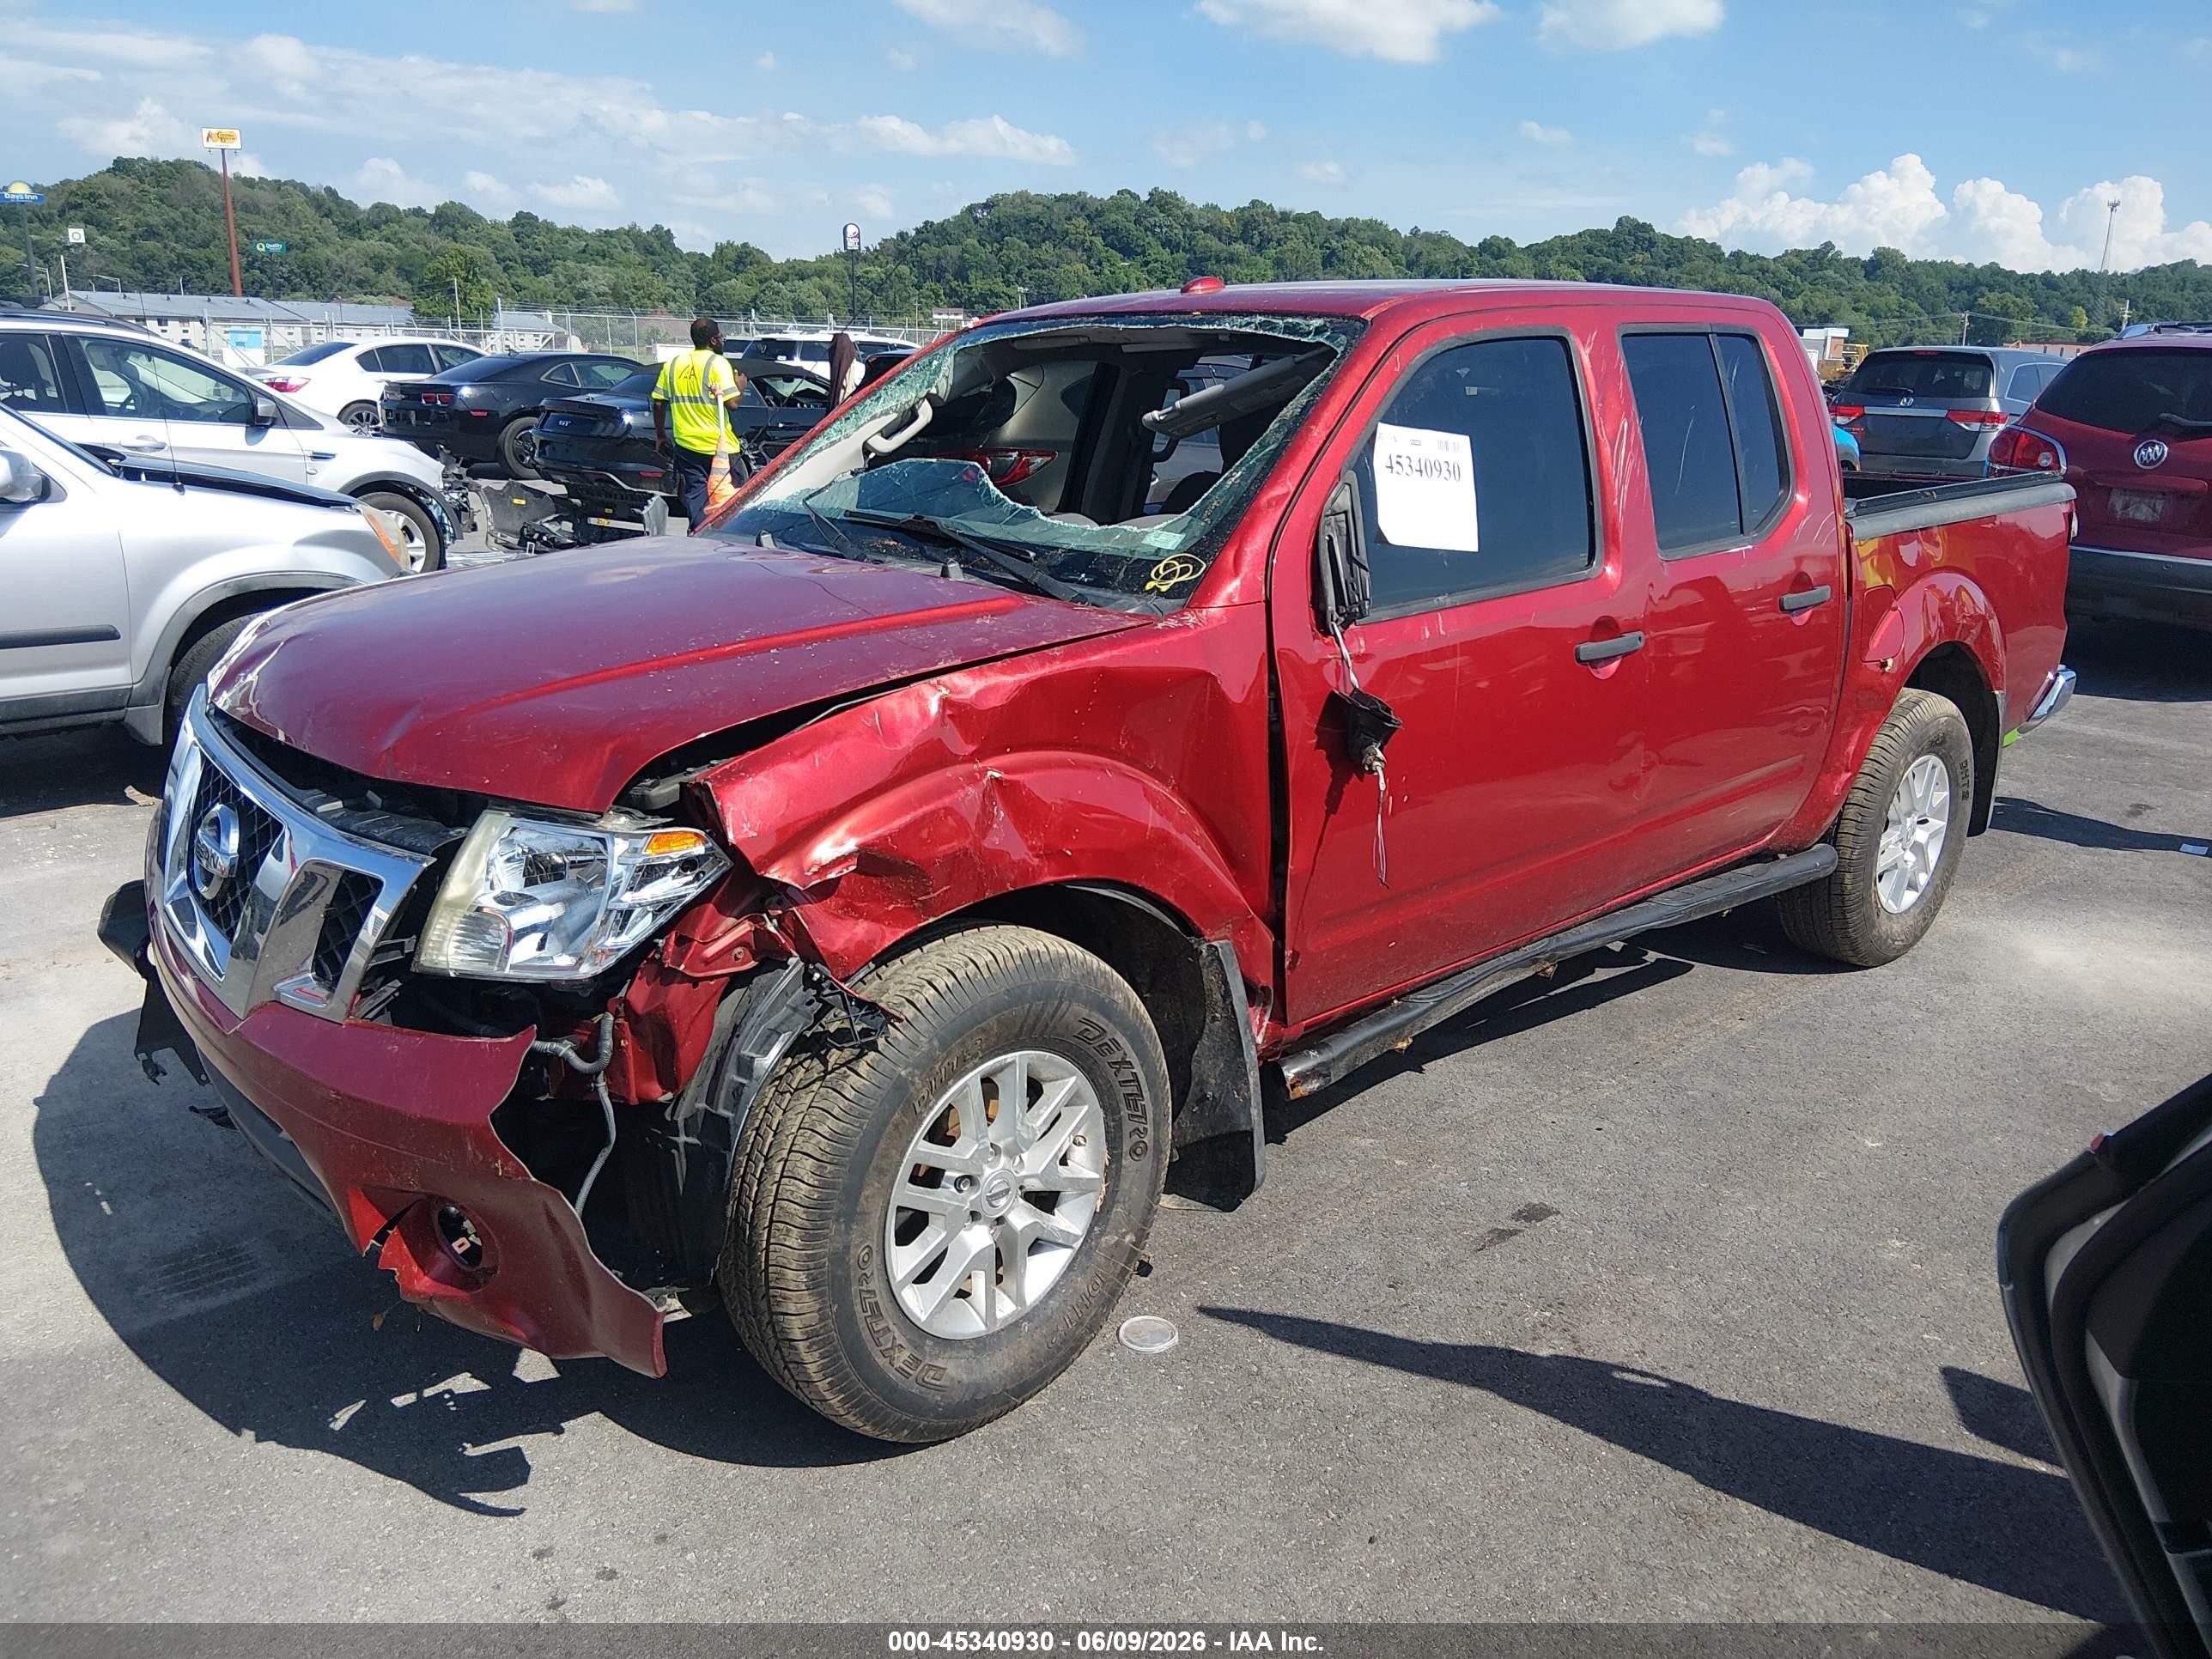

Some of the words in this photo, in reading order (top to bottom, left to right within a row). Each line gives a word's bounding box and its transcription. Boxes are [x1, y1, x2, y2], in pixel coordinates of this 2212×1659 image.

[1385, 453, 1461, 482] 45340930
[1073, 1017, 1148, 1161] DEXTERO
[857, 1244, 948, 1393] DEXTERO
